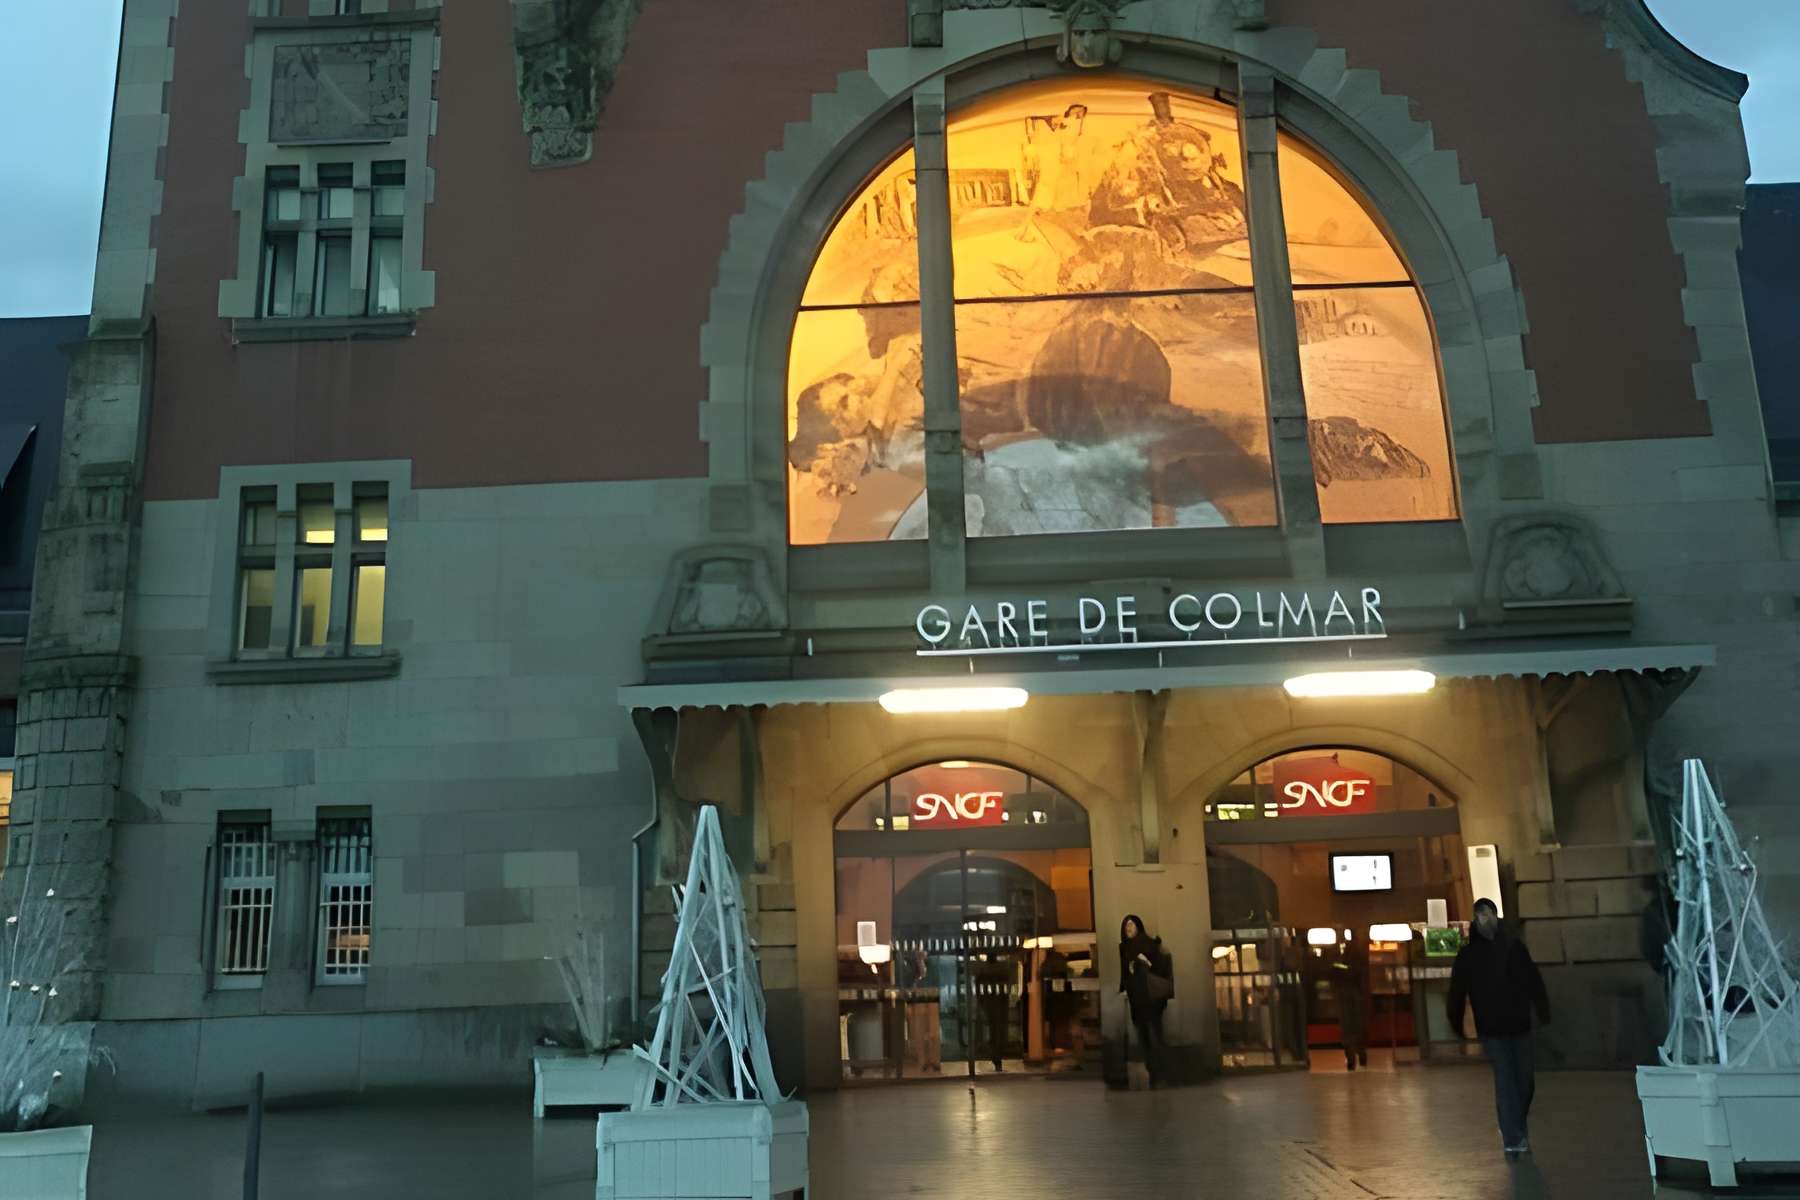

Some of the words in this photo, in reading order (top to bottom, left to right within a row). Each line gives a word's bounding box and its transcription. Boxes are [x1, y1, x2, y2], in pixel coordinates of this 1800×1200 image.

[915, 600, 1050, 648] GARE
[1078, 596, 1139, 642] DE
[1168, 587, 1386, 637] COLMAR
[912, 790, 1005, 822] SNCF
[1281, 779, 1371, 809] SNCF
